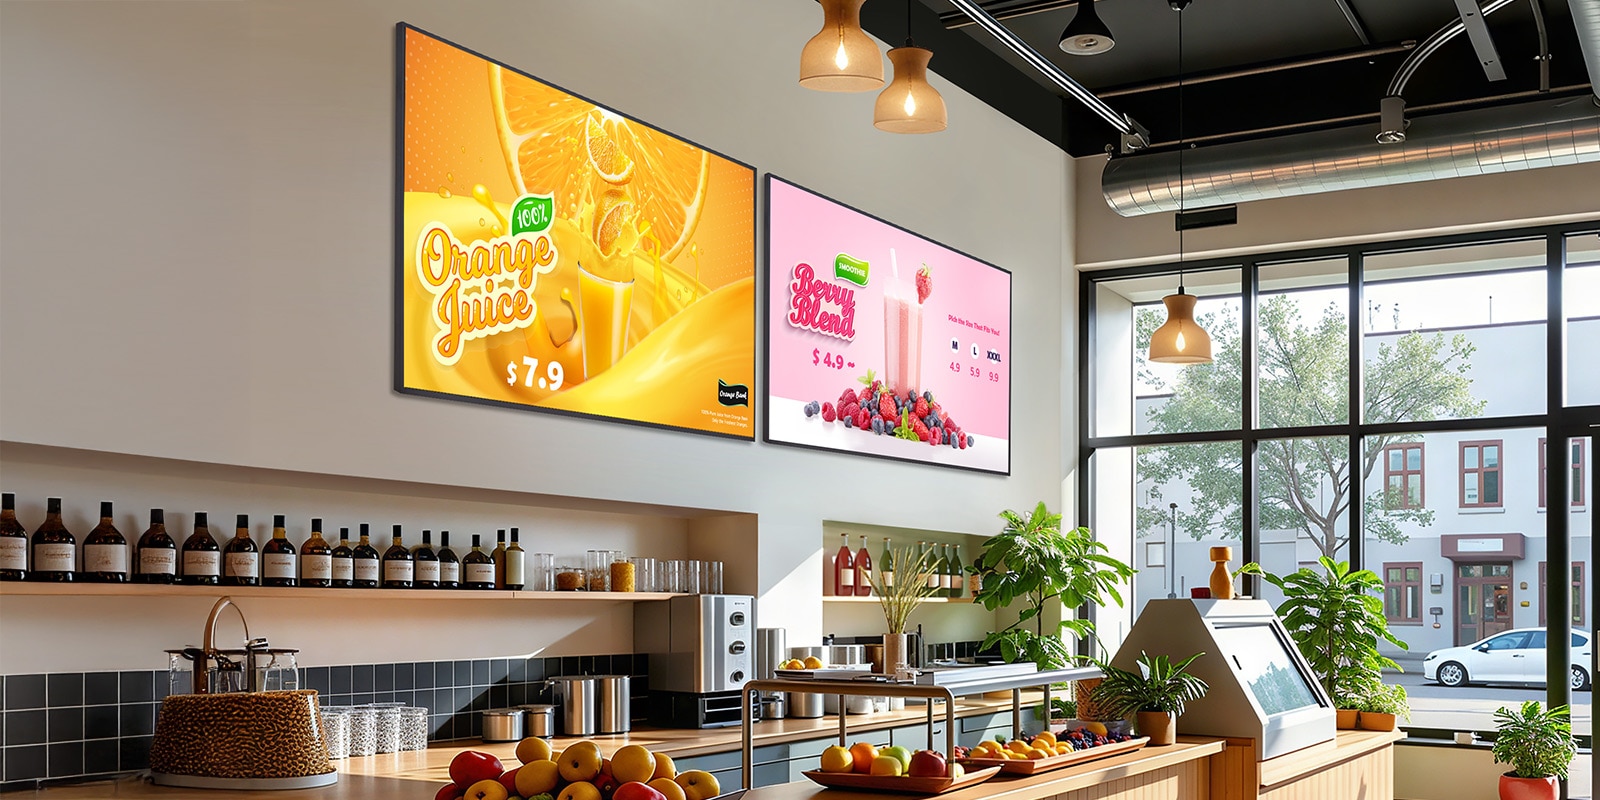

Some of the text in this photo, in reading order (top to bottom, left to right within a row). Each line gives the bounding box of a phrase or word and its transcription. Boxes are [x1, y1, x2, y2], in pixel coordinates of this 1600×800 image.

[517, 203, 548, 229] 100%
[421, 228, 554, 290] Orange
[838, 262, 866, 277] SMOOTHIE
[792, 263, 855, 317] Berry
[437, 278, 533, 358] Juice
[789, 293, 855, 339] Blend
[974, 322, 983, 331] That
[952, 340, 958, 350] M
[812, 348, 820, 366] $
[823, 352, 844, 370] 4.9
[950, 362, 999, 382] 4.9 5.9 9.9
[506, 356, 564, 392] $ 7.9
